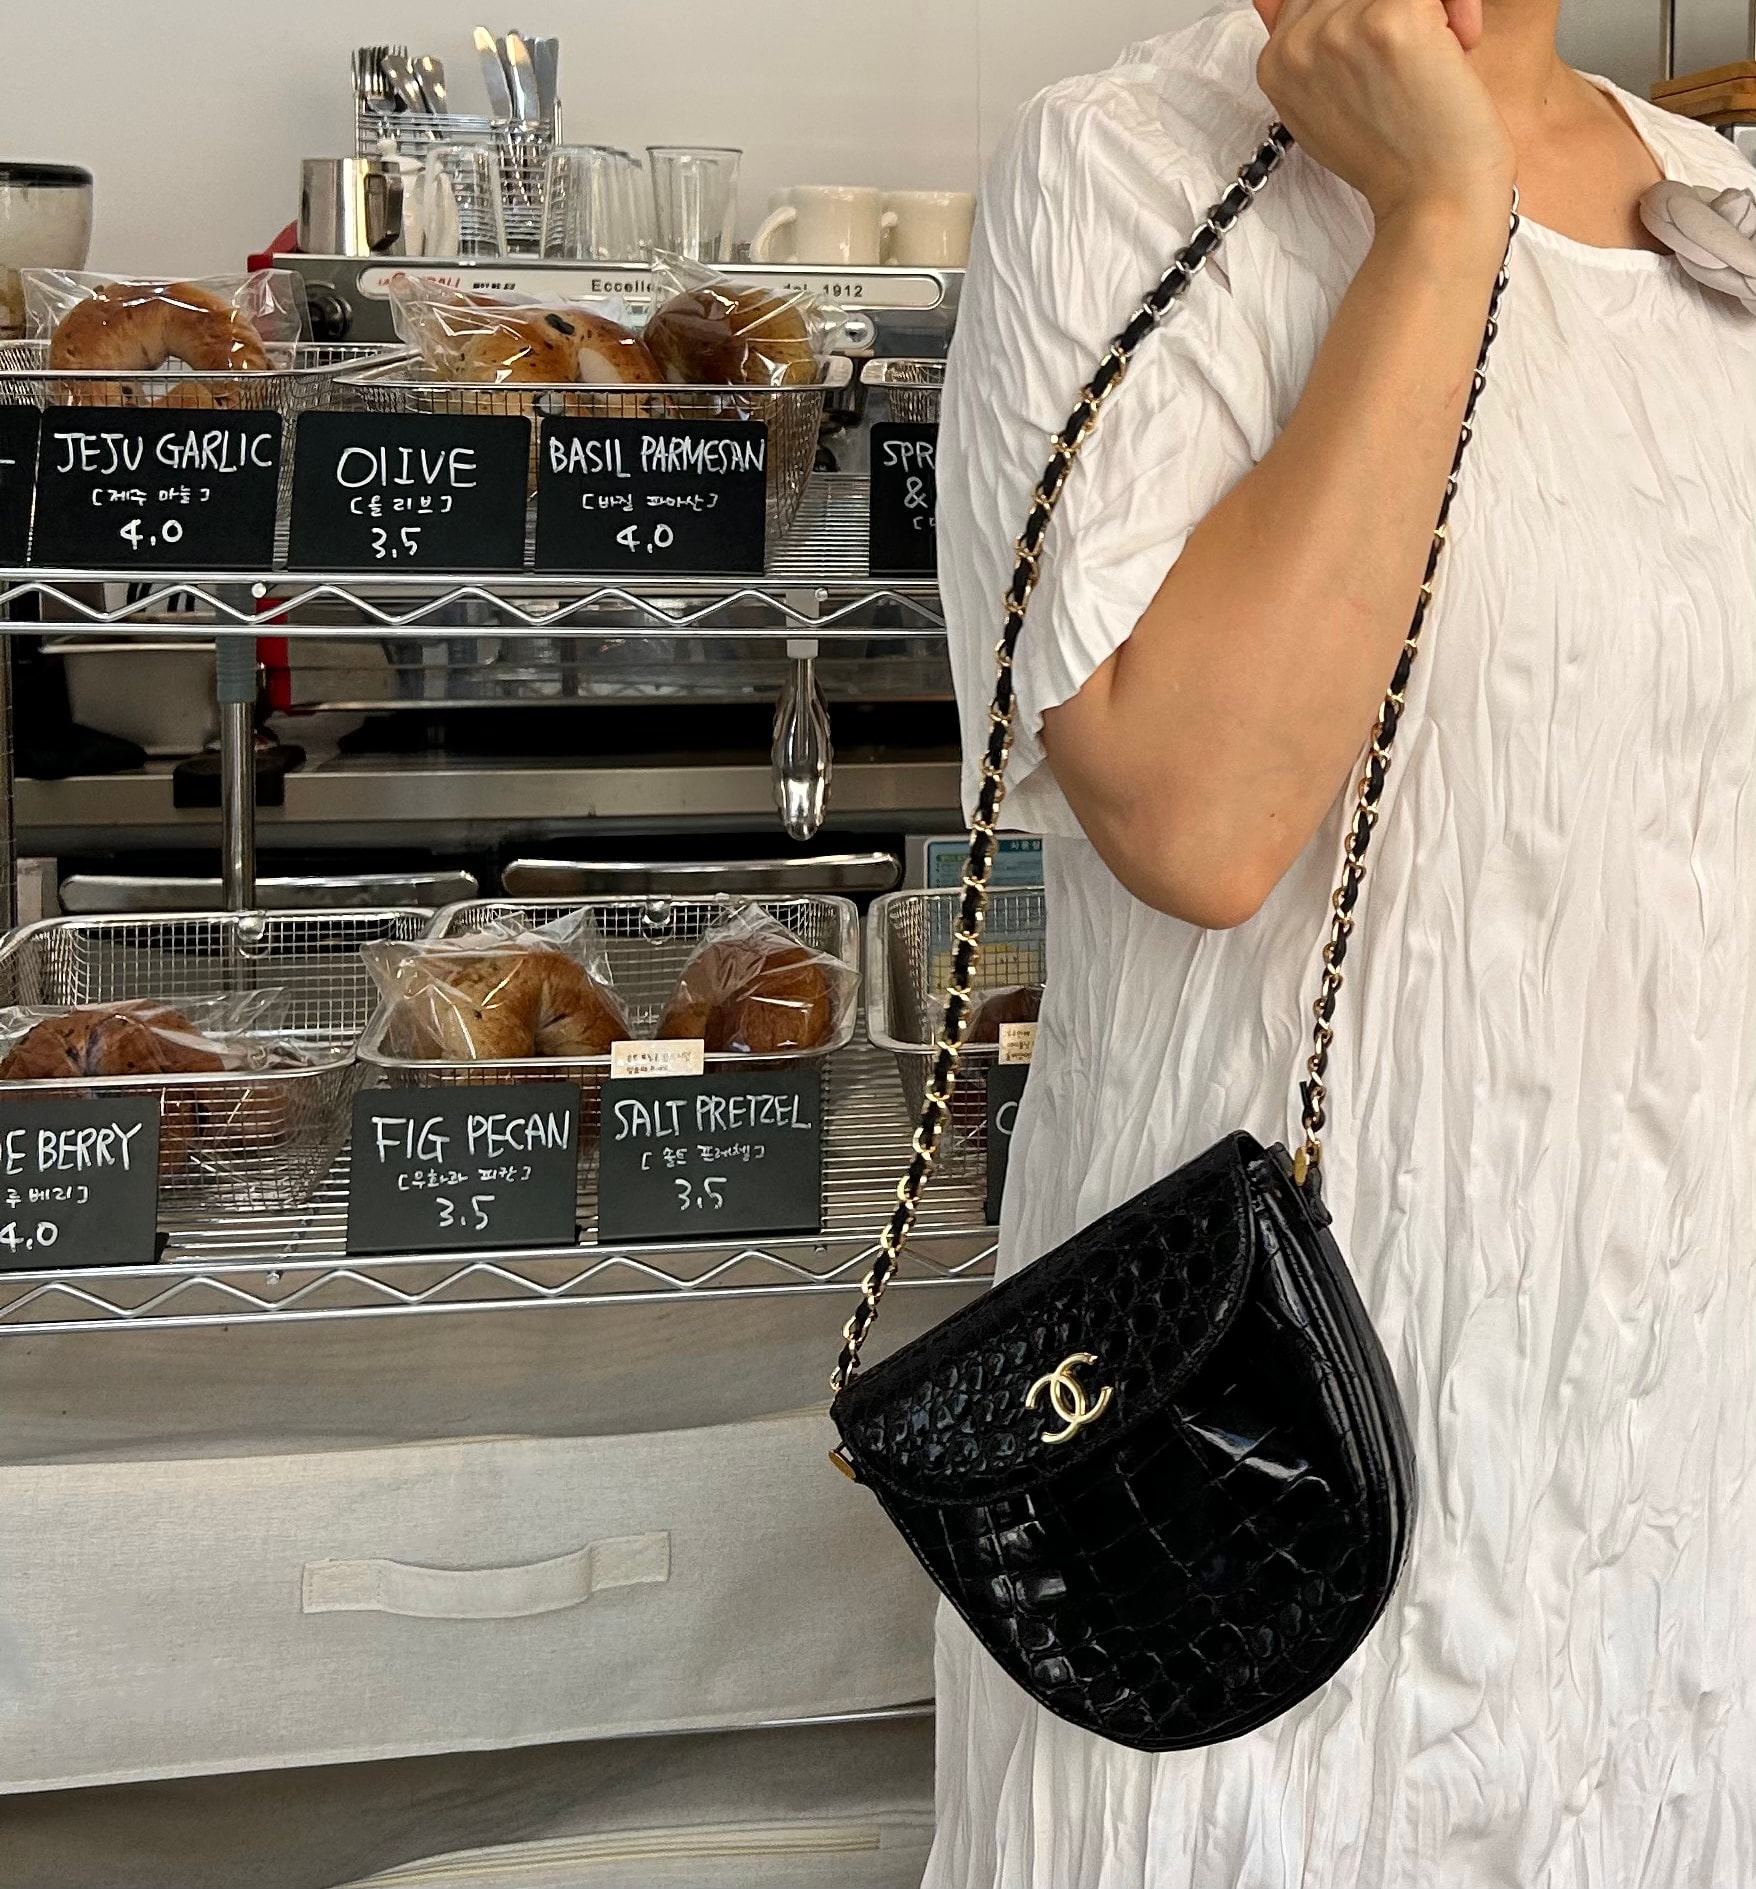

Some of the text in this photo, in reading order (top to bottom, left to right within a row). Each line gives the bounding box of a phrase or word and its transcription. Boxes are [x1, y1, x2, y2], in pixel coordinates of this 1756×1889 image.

[591, 279, 653, 293] Eccelle
[822, 284, 863, 297] 1912
[54, 430, 272, 474] JEJU GARLIC
[550, 436, 764, 477] BASIL PARMESAN
[904, 477, 928, 508] &
[372, 1111, 569, 1163] FIG PECAN
[615, 1095, 811, 1140] SALT PRETZEL
[0, 1123, 142, 1174] E BERRY
